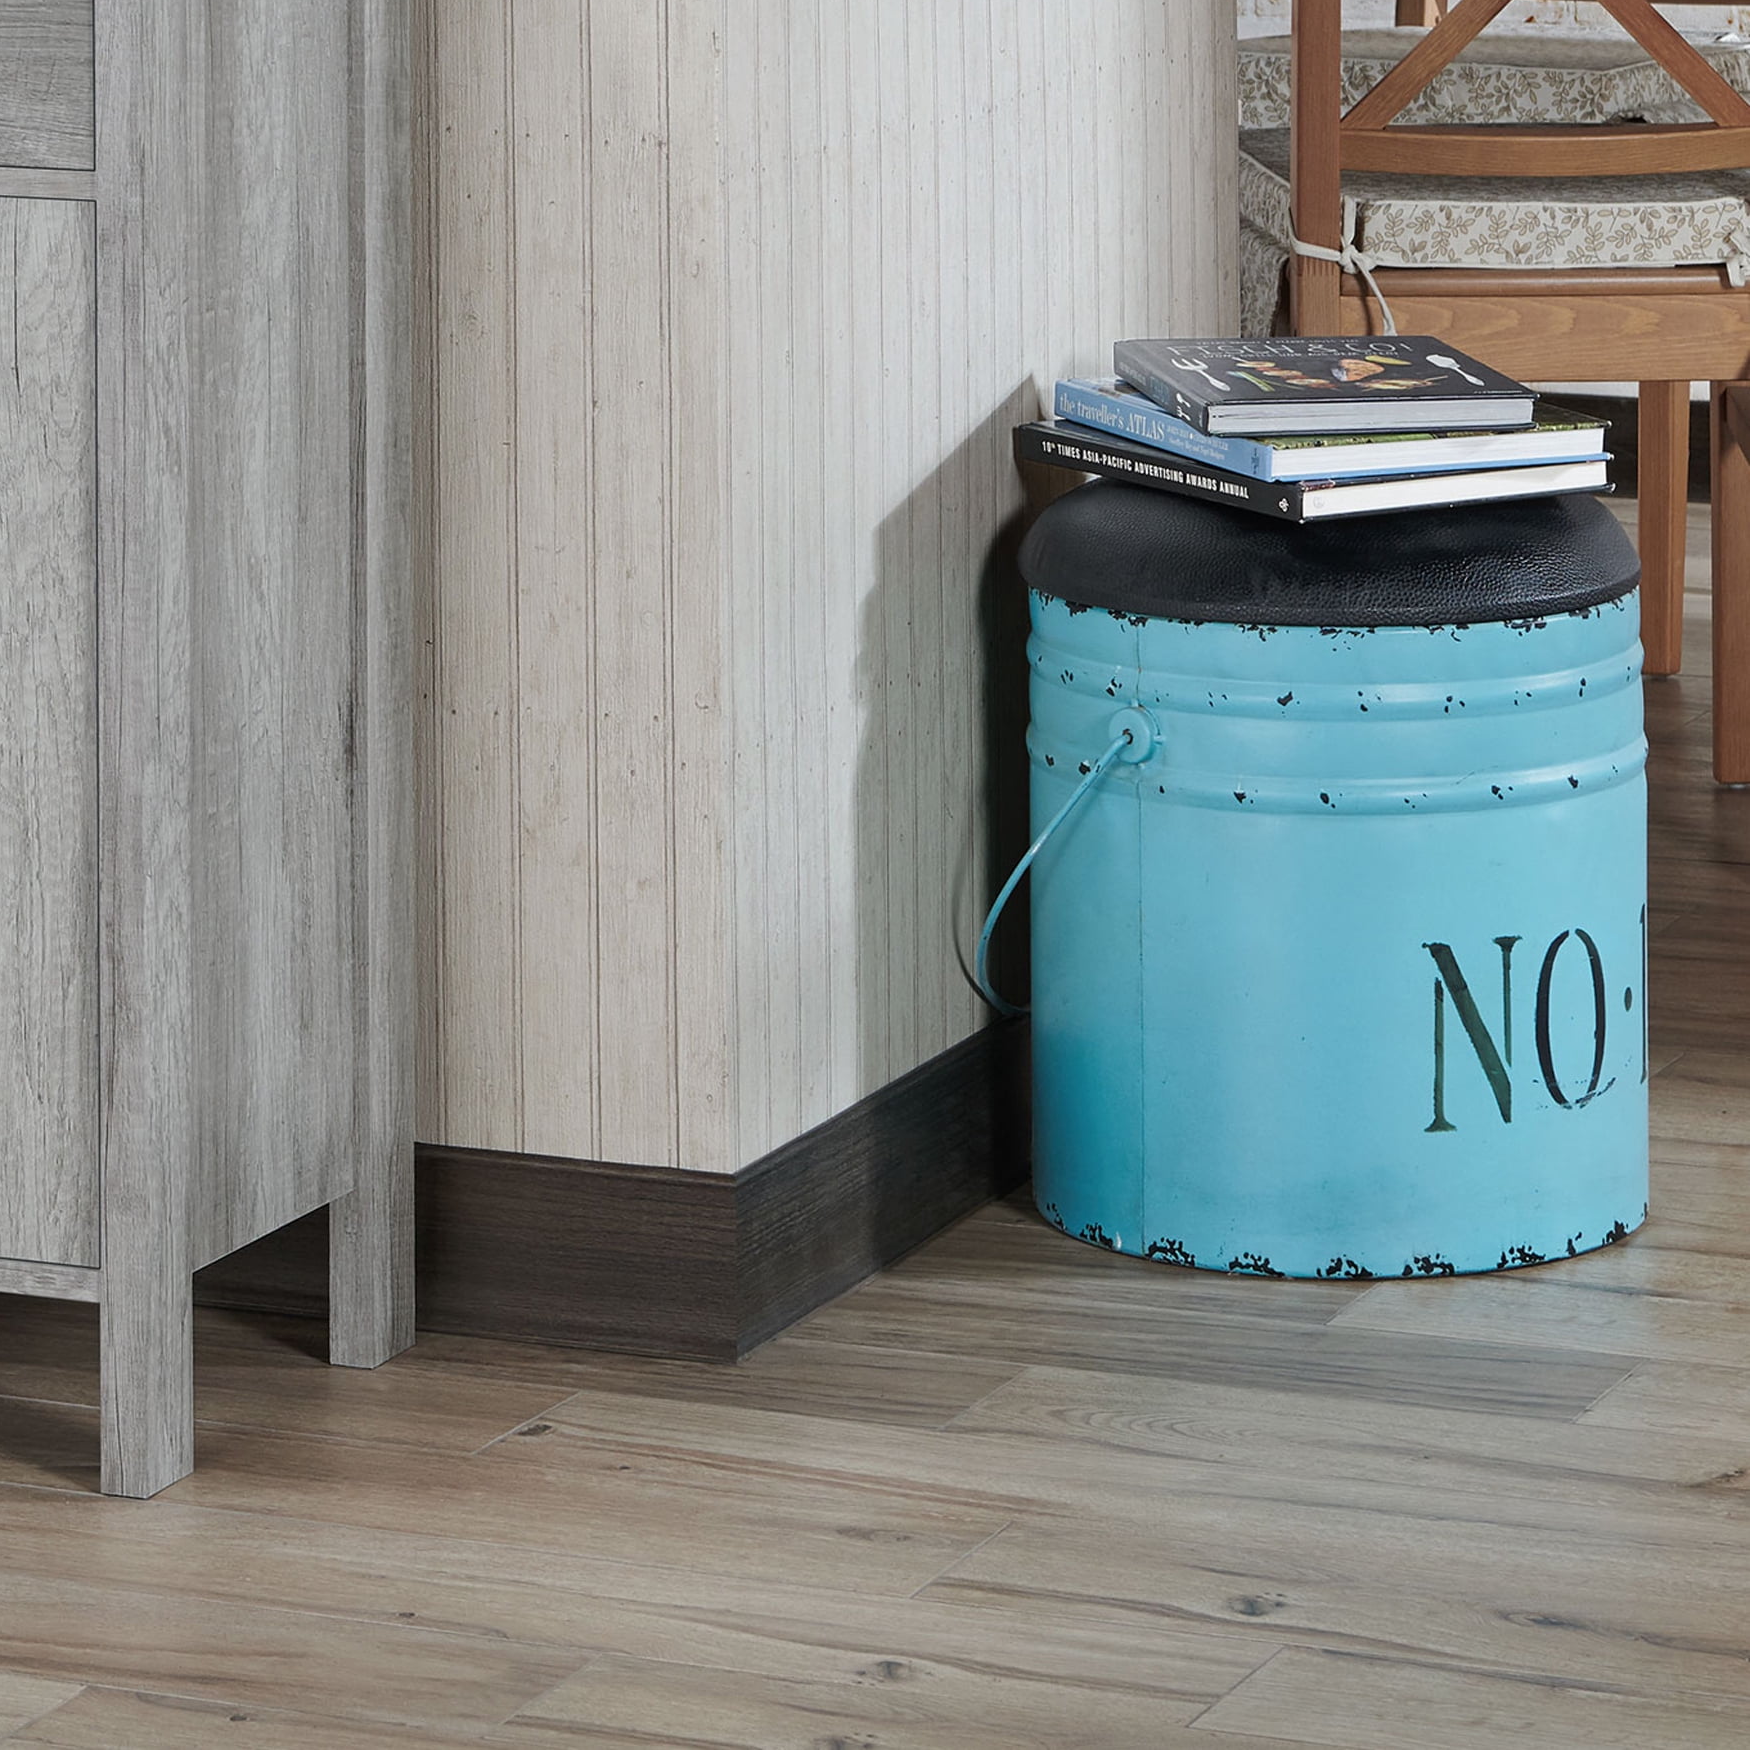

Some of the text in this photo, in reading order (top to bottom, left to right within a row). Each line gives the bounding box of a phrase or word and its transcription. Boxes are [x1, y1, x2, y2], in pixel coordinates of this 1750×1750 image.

[1059, 392, 1076, 413] the
[1077, 399, 1124, 429] traveller's
[1126, 412, 1166, 443] ATLAS
[1057, 443, 1081, 460] TIMES
[1082, 450, 1133, 472] ASIA-PACIFIC
[1133, 462, 1184, 485] ADVERTISING
[1185, 473, 1218, 492] AWARDS
[1219, 483, 1249, 500] ANNUAL
